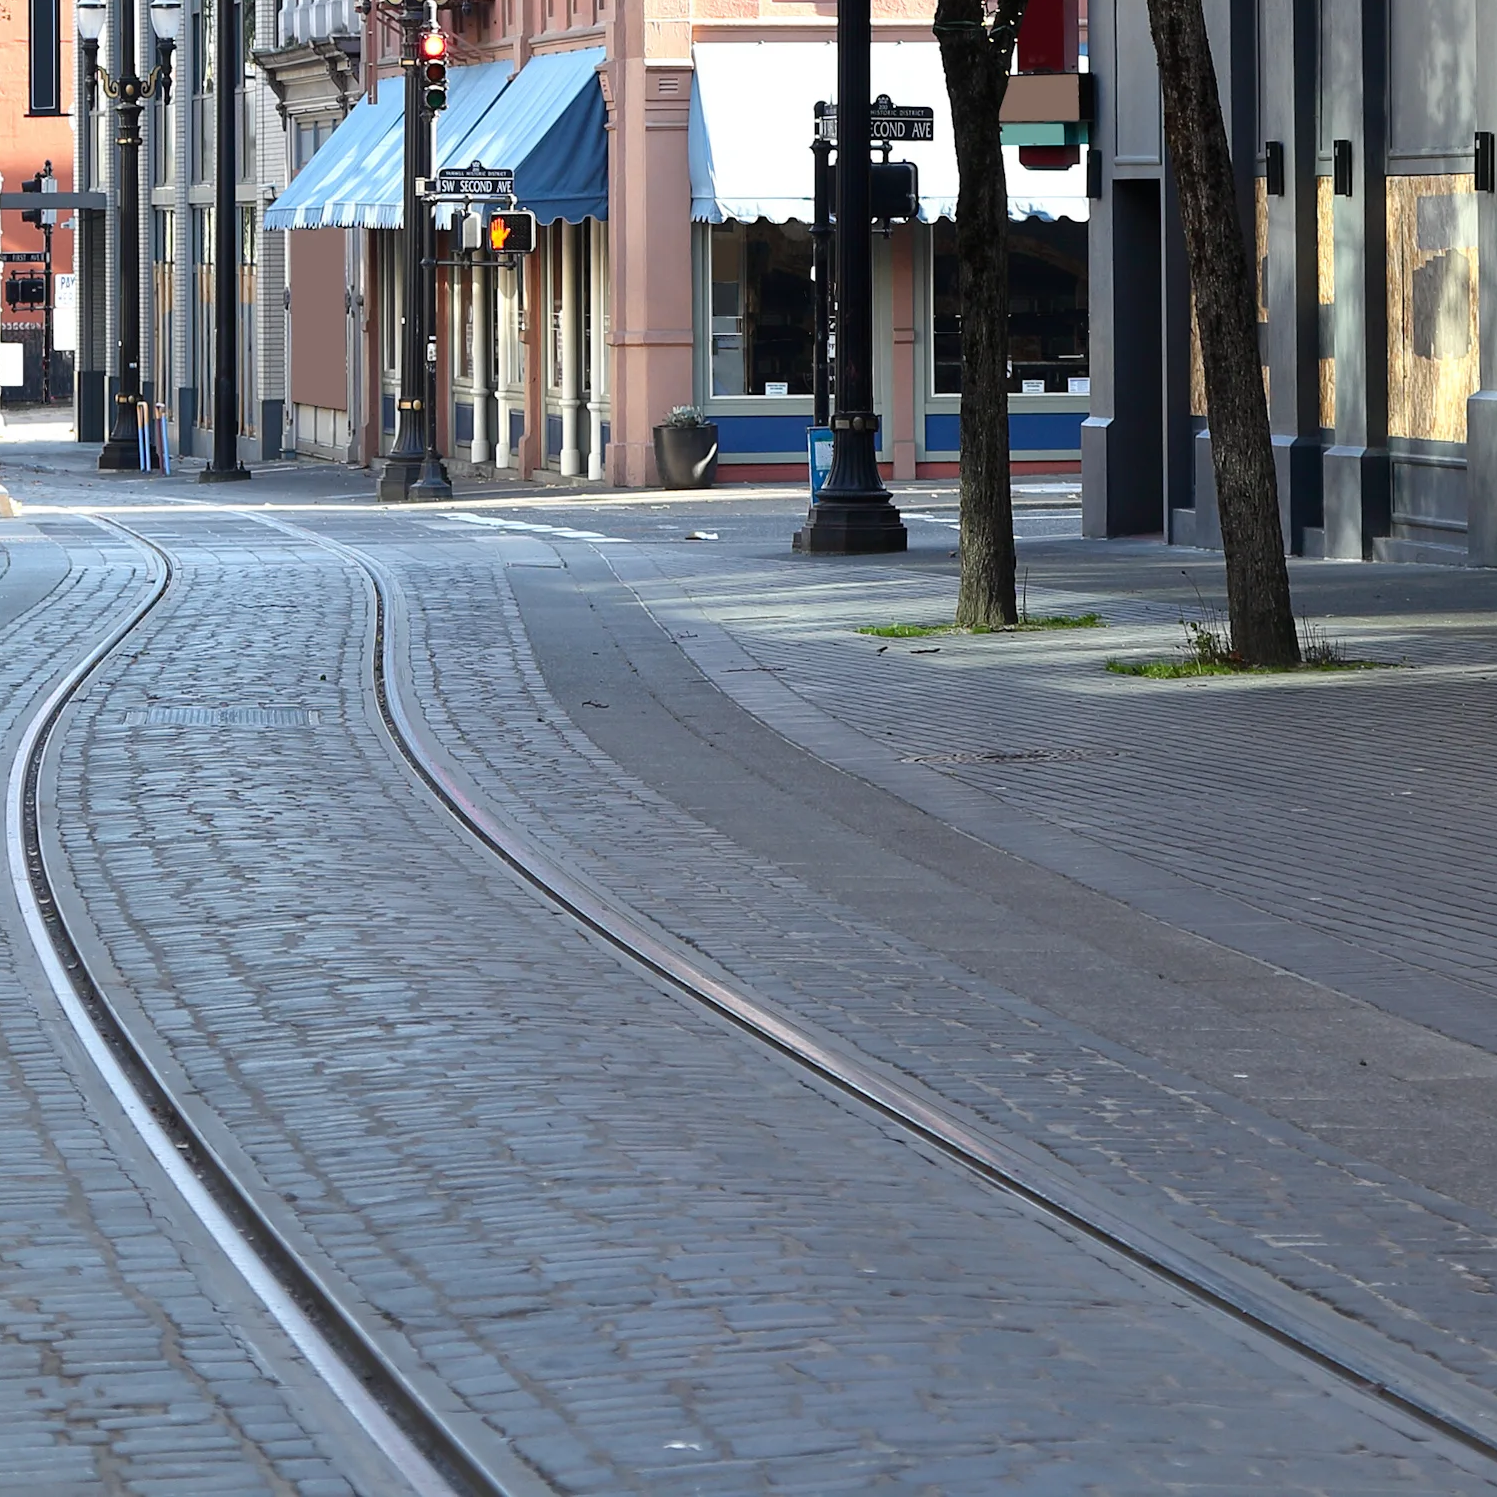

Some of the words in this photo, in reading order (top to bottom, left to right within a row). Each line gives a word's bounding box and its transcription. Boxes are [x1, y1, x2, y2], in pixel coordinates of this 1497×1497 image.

[911, 122, 932, 138] AVE
[441, 180, 455, 192] SW
[460, 180, 492, 192] SECOND
[496, 180, 512, 192] AVE
